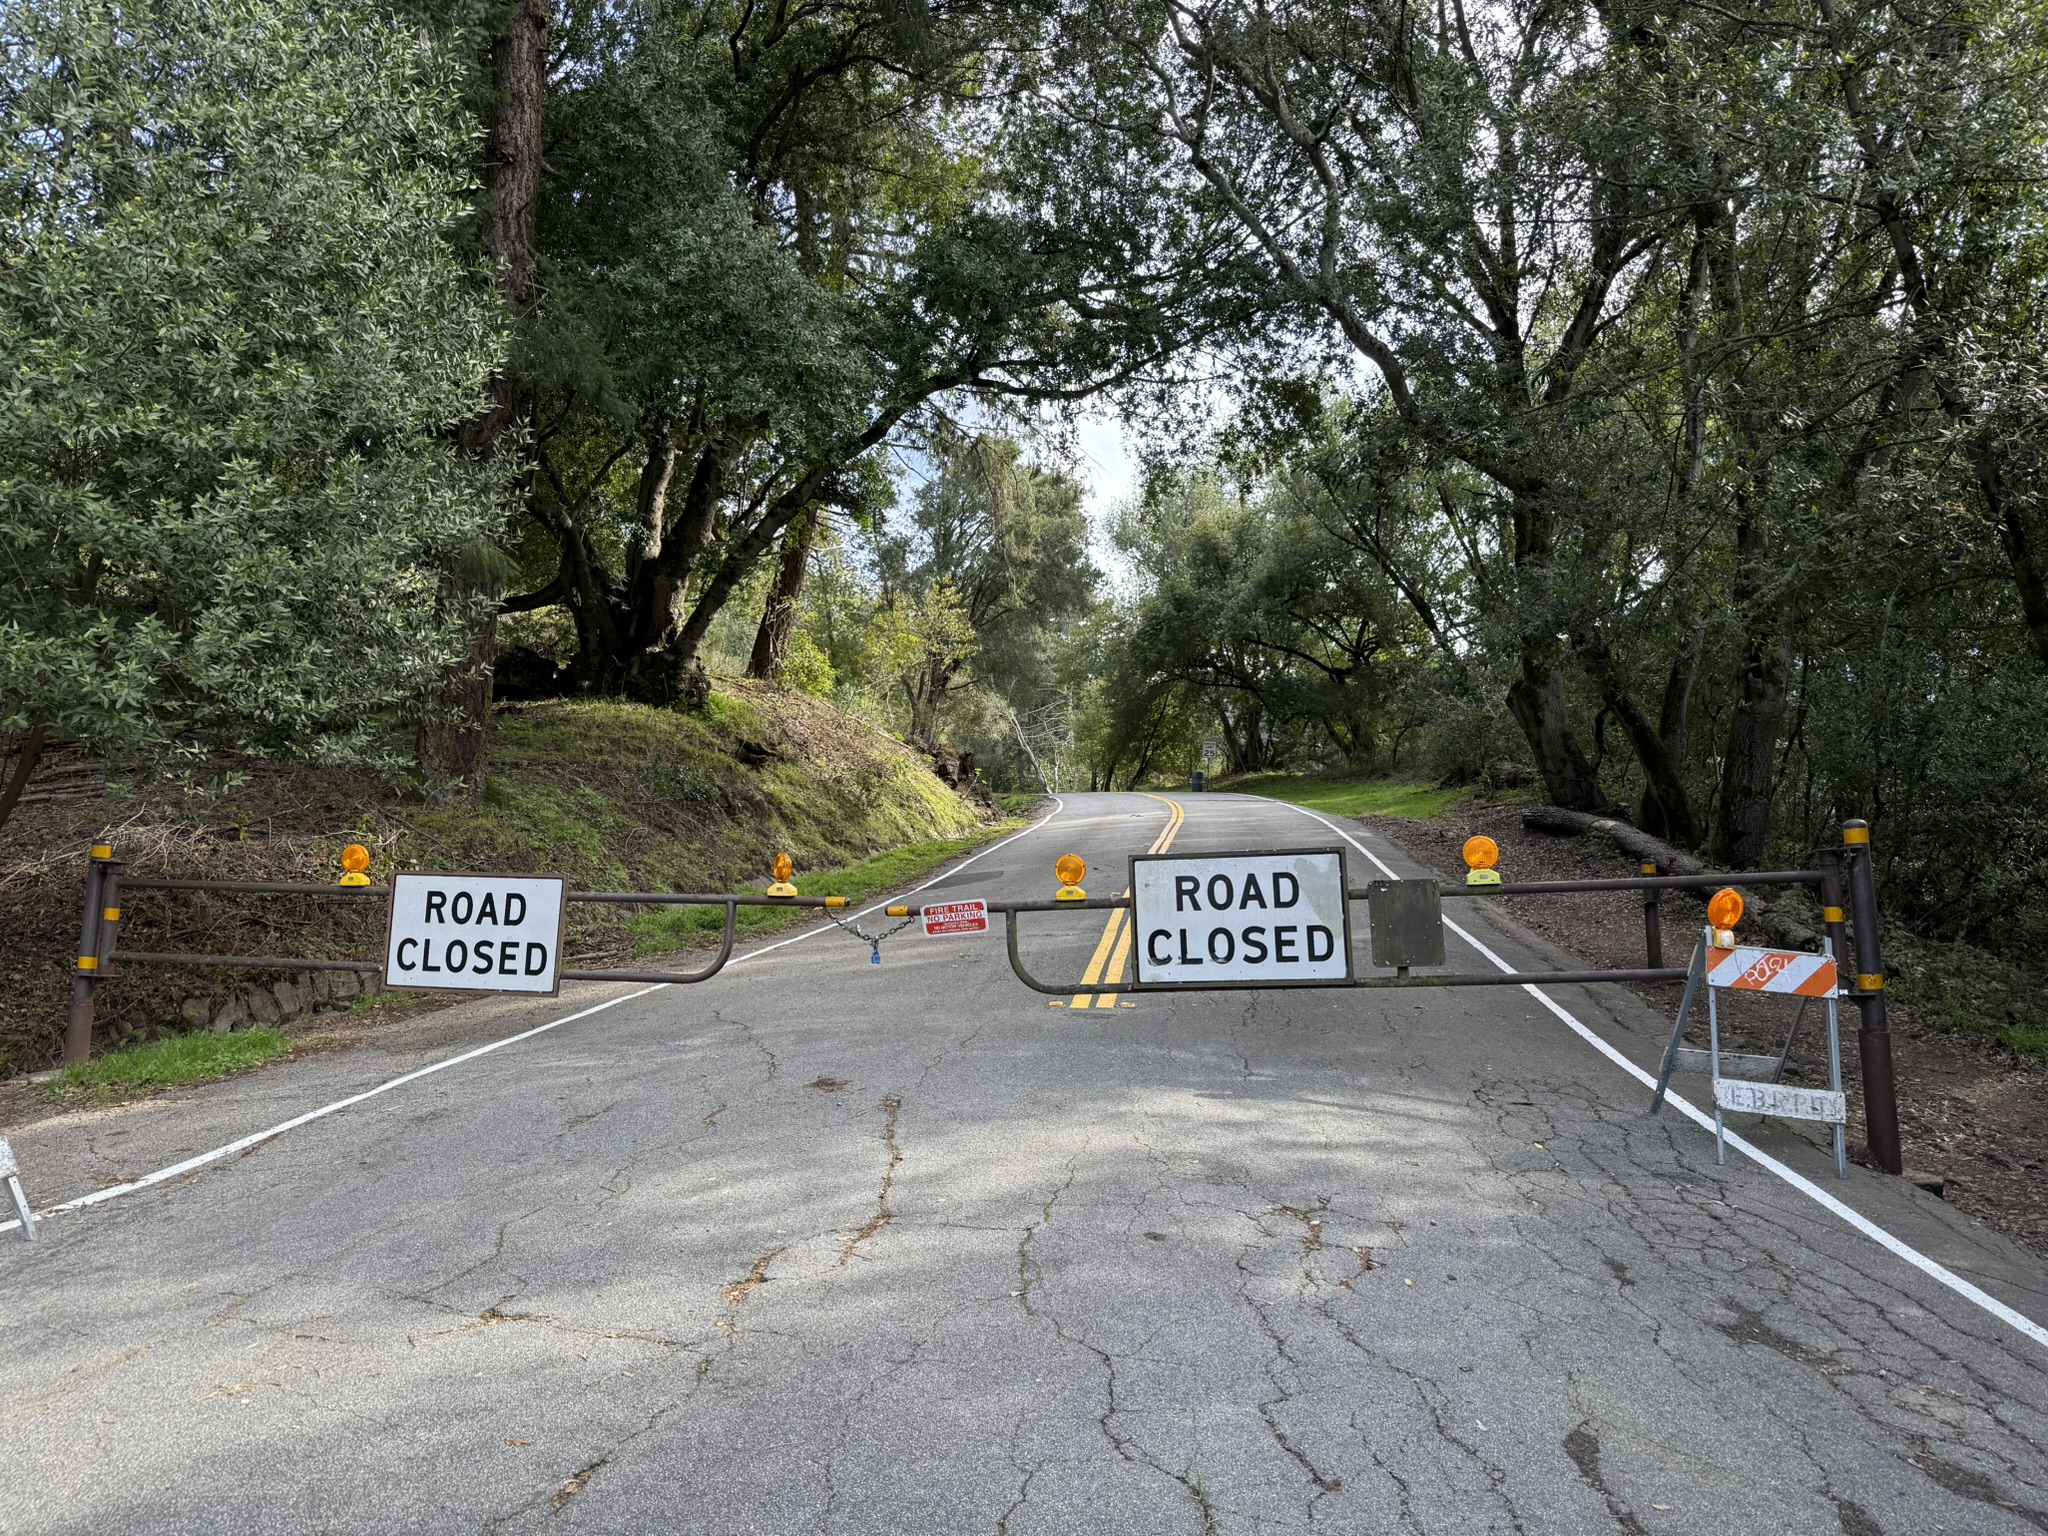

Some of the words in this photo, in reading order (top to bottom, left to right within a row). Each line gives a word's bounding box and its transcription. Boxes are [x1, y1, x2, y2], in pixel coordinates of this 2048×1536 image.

[425, 891, 527, 926] ROAD
[930, 906, 950, 915] FIRE
[952, 903, 977, 912] TRAIL
[1175, 872, 1300, 912] ROAD
[927, 915, 940, 923] NO
[943, 911, 983, 921] PARKING
[397, 938, 548, 976] CLOSED
[1147, 925, 1334, 967] CLOSED
